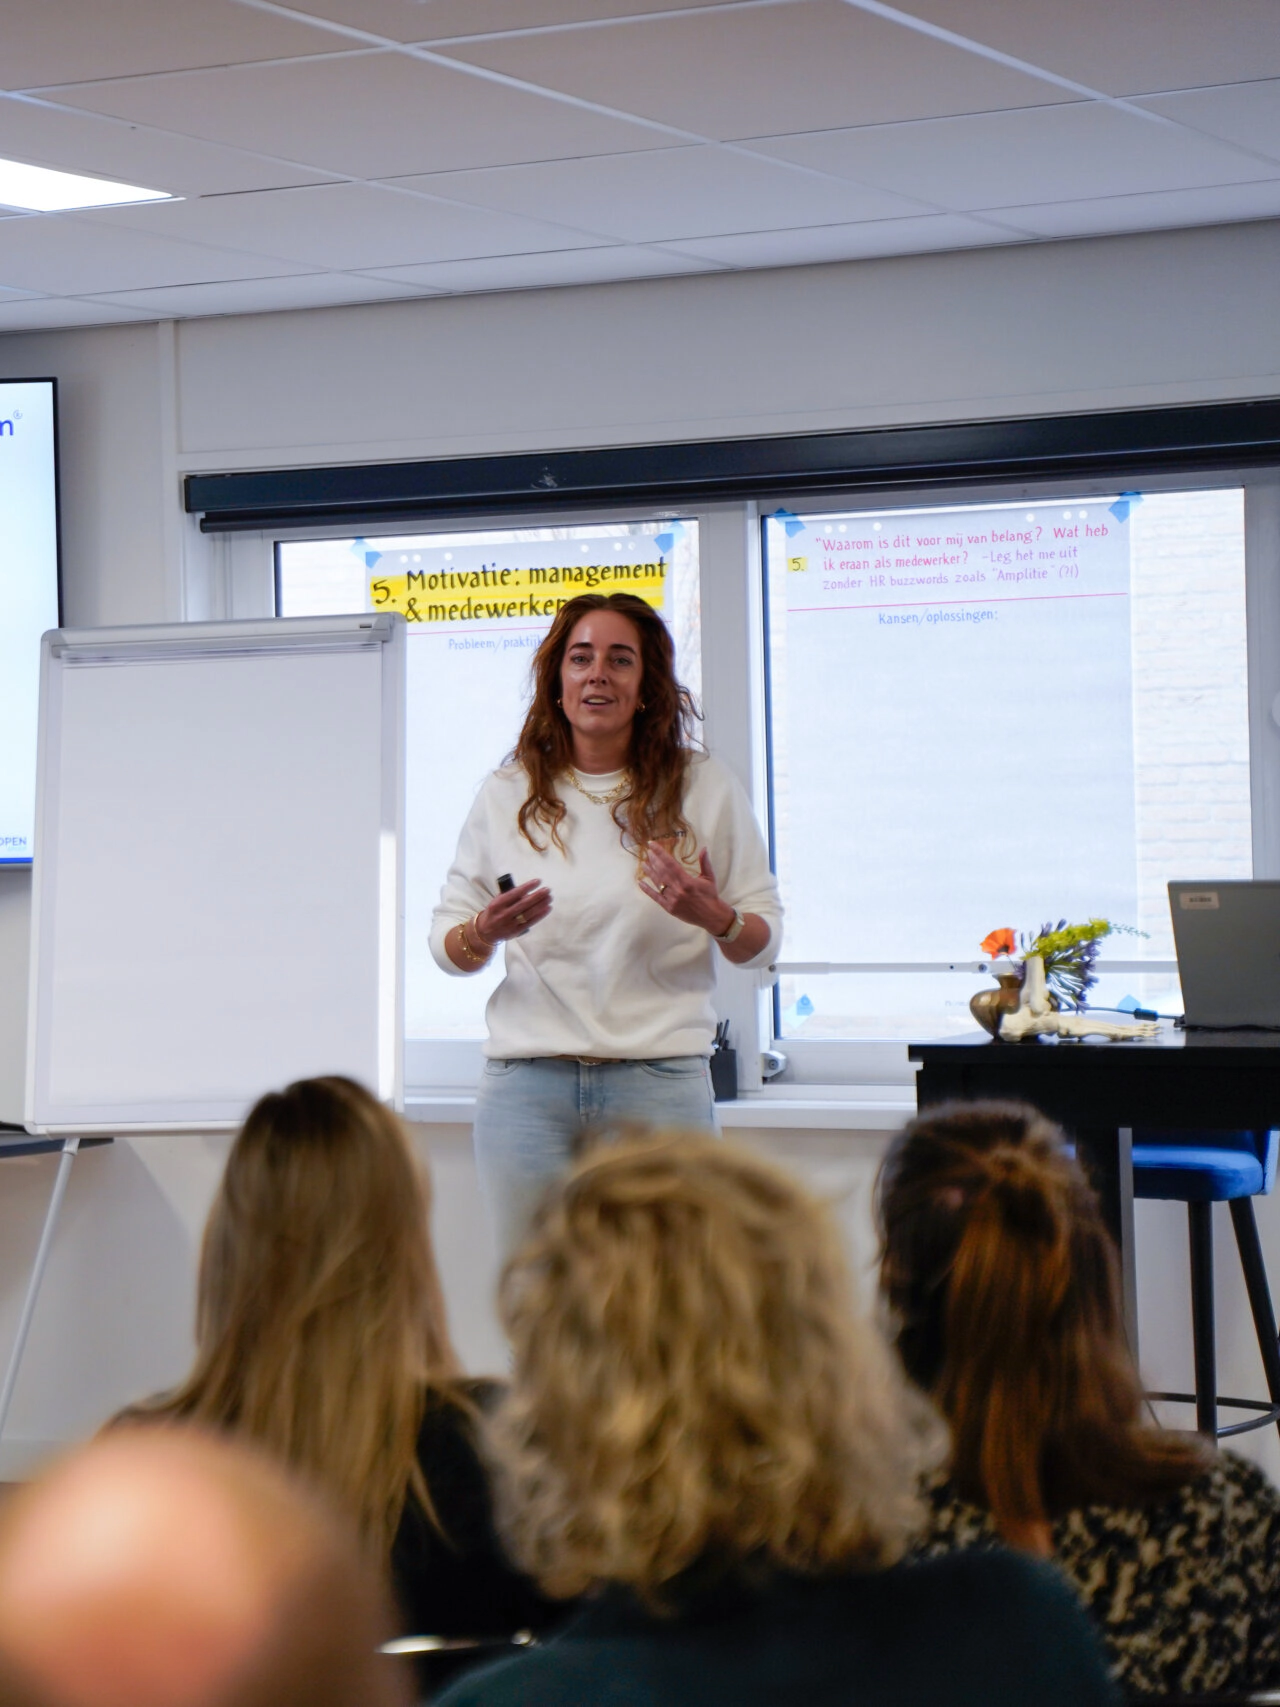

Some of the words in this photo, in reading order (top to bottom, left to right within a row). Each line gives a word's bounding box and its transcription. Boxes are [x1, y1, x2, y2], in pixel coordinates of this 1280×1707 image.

[878, 535, 889, 549] is
[893, 534, 911, 549] dit
[916, 536, 942, 547] voor
[946, 532, 963, 548] mij
[967, 534, 988, 545] van
[1053, 525, 1080, 539] Wat
[1085, 524, 1110, 537] heb
[792, 557, 805, 572] 5.
[823, 556, 835, 571] ik
[839, 559, 870, 571] eraan
[874, 556, 892, 569] als
[1016, 548, 1034, 561] het
[1038, 551, 1056, 560] me
[1059, 546, 1078, 559] uit
[373, 579, 397, 605] 5.
[406, 562, 521, 592] Motivatie:
[528, 556, 667, 587] management
[823, 577, 863, 590] zonder
[870, 575, 886, 588] HR
[890, 573, 949, 587] buzzwords
[955, 570, 986, 583] zoals
[405, 597, 423, 623] &
